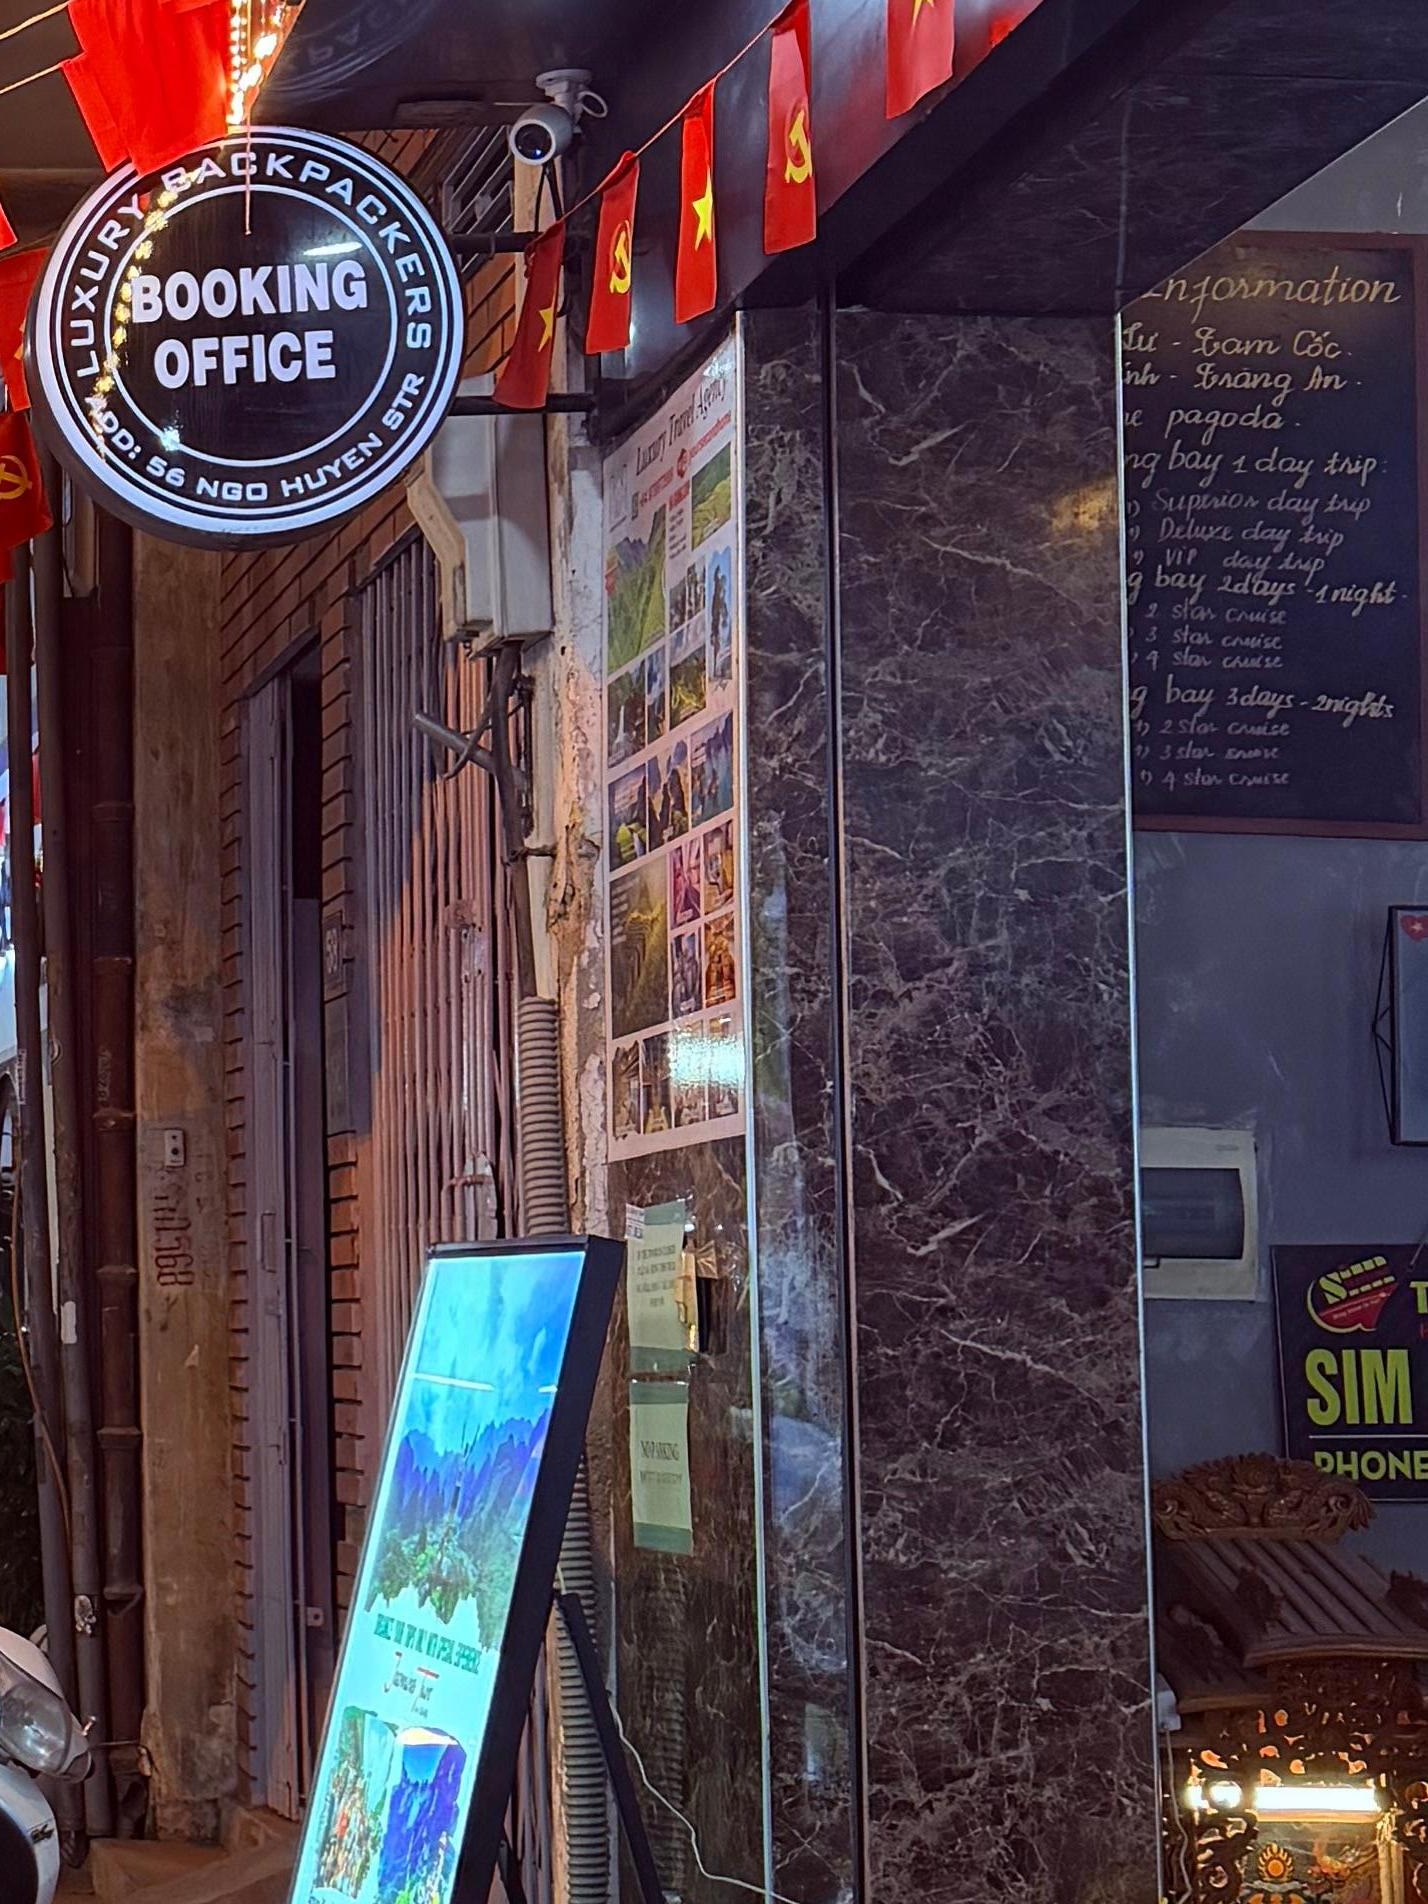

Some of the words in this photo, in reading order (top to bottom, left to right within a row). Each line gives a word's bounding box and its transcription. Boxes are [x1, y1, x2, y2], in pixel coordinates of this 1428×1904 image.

[69, 194, 144, 377] LUXURY
[162, 151, 431, 350] BACKPACKERS
[131, 259, 368, 323] BOOKING
[153, 330, 337, 388] OFFICE
[146, 455, 185, 487] 56
[196, 479, 267, 501] NGO
[281, 434, 385, 498] HUYEN
[383, 371, 425, 434] STR
[636, 431, 666, 476] Luxury
[669, 393, 695, 447] Travel
[1168, 440, 1222, 488] bay
[1255, 447, 1313, 488] day
[1305, 1348, 1413, 1426] SIM
